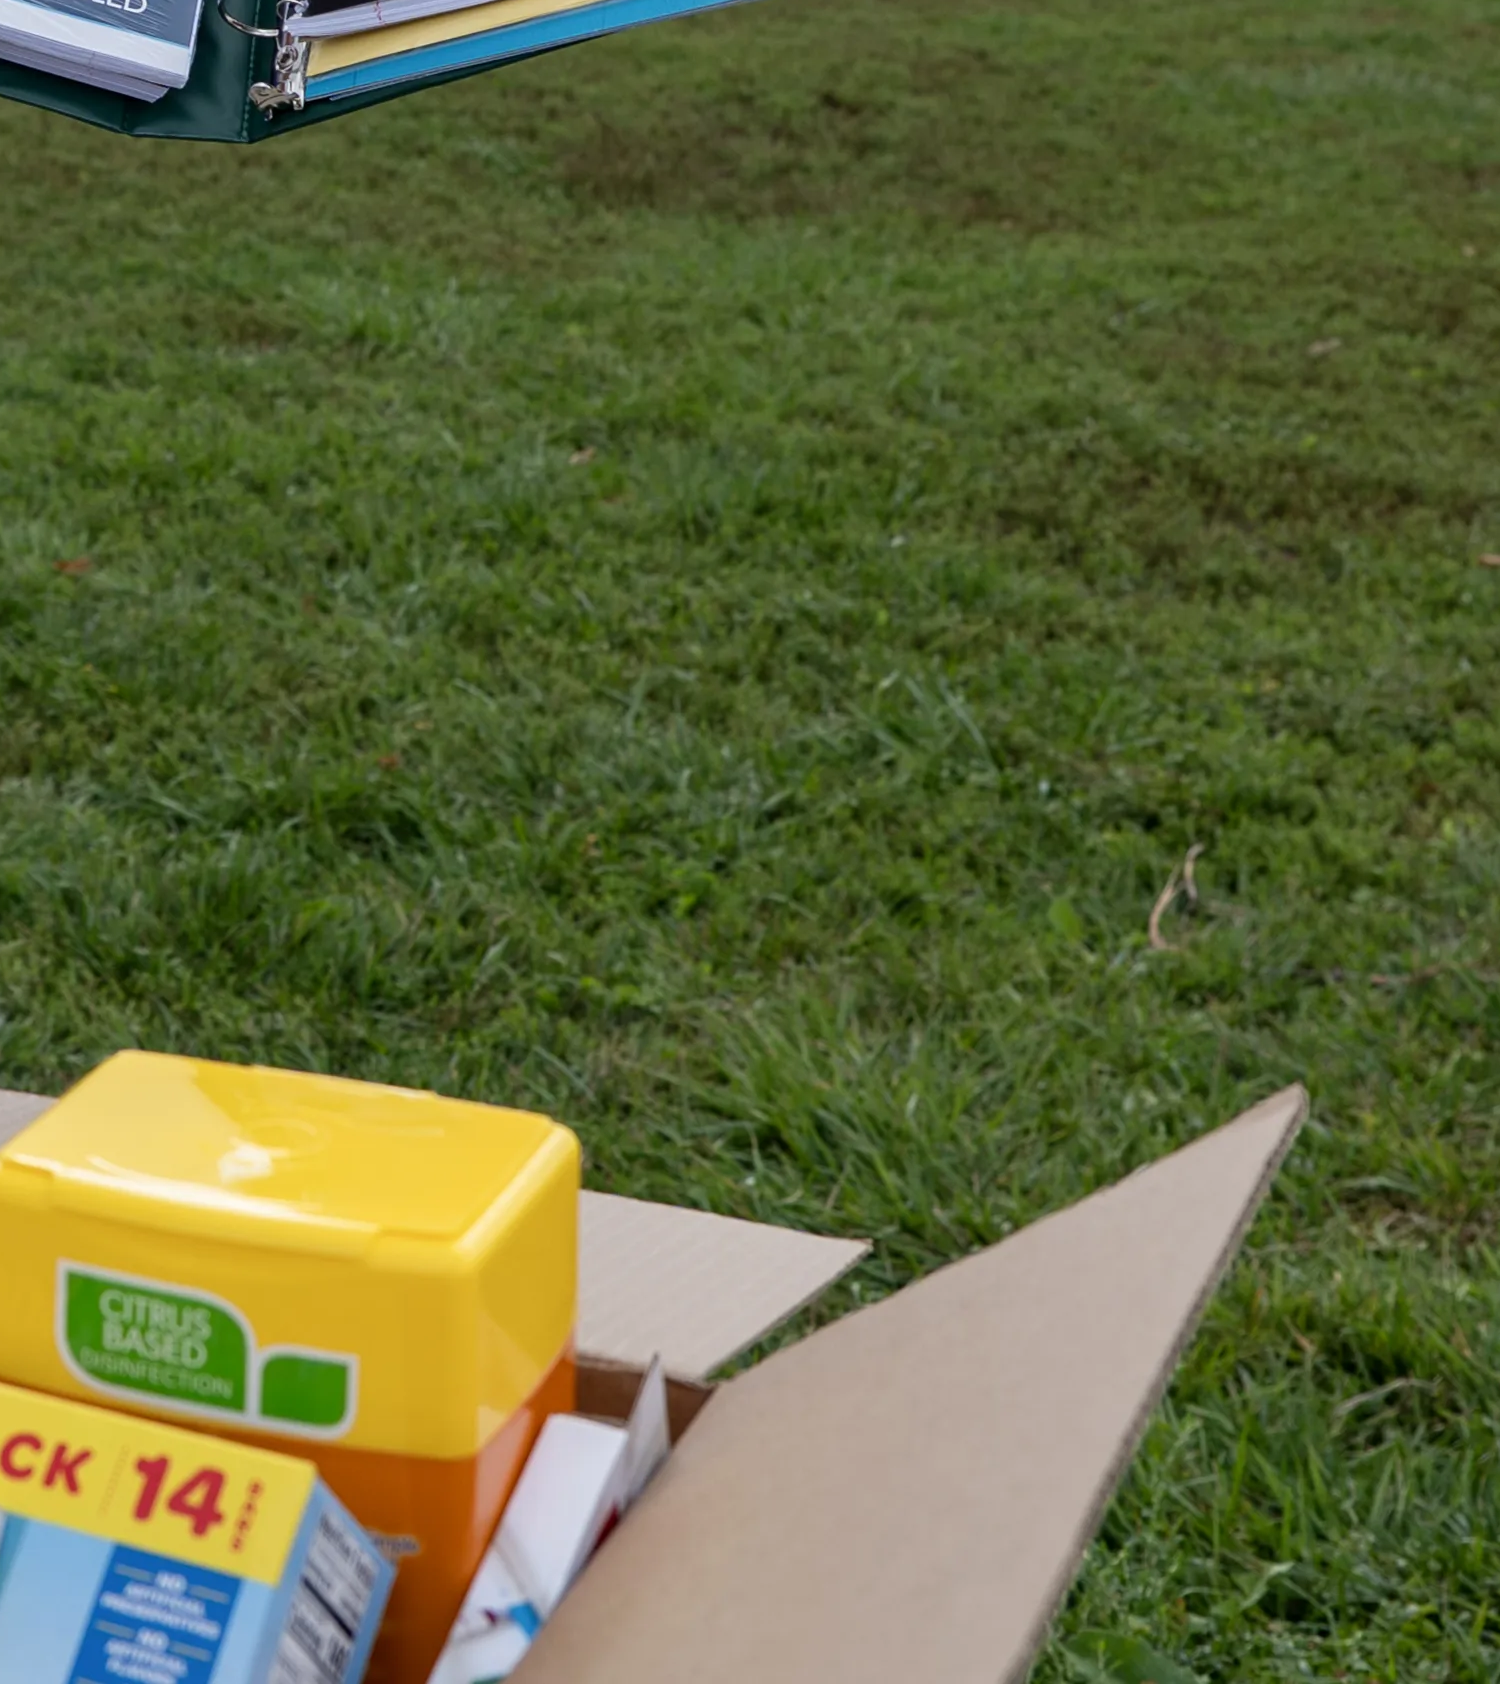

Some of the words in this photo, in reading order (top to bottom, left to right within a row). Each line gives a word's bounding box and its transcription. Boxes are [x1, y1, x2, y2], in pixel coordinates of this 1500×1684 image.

[99, 1288, 213, 1340] CITRUS
[102, 1317, 208, 1369] BASED
[79, 1345, 234, 1399] DISINFECTION
[134, 1455, 225, 1536] 14
